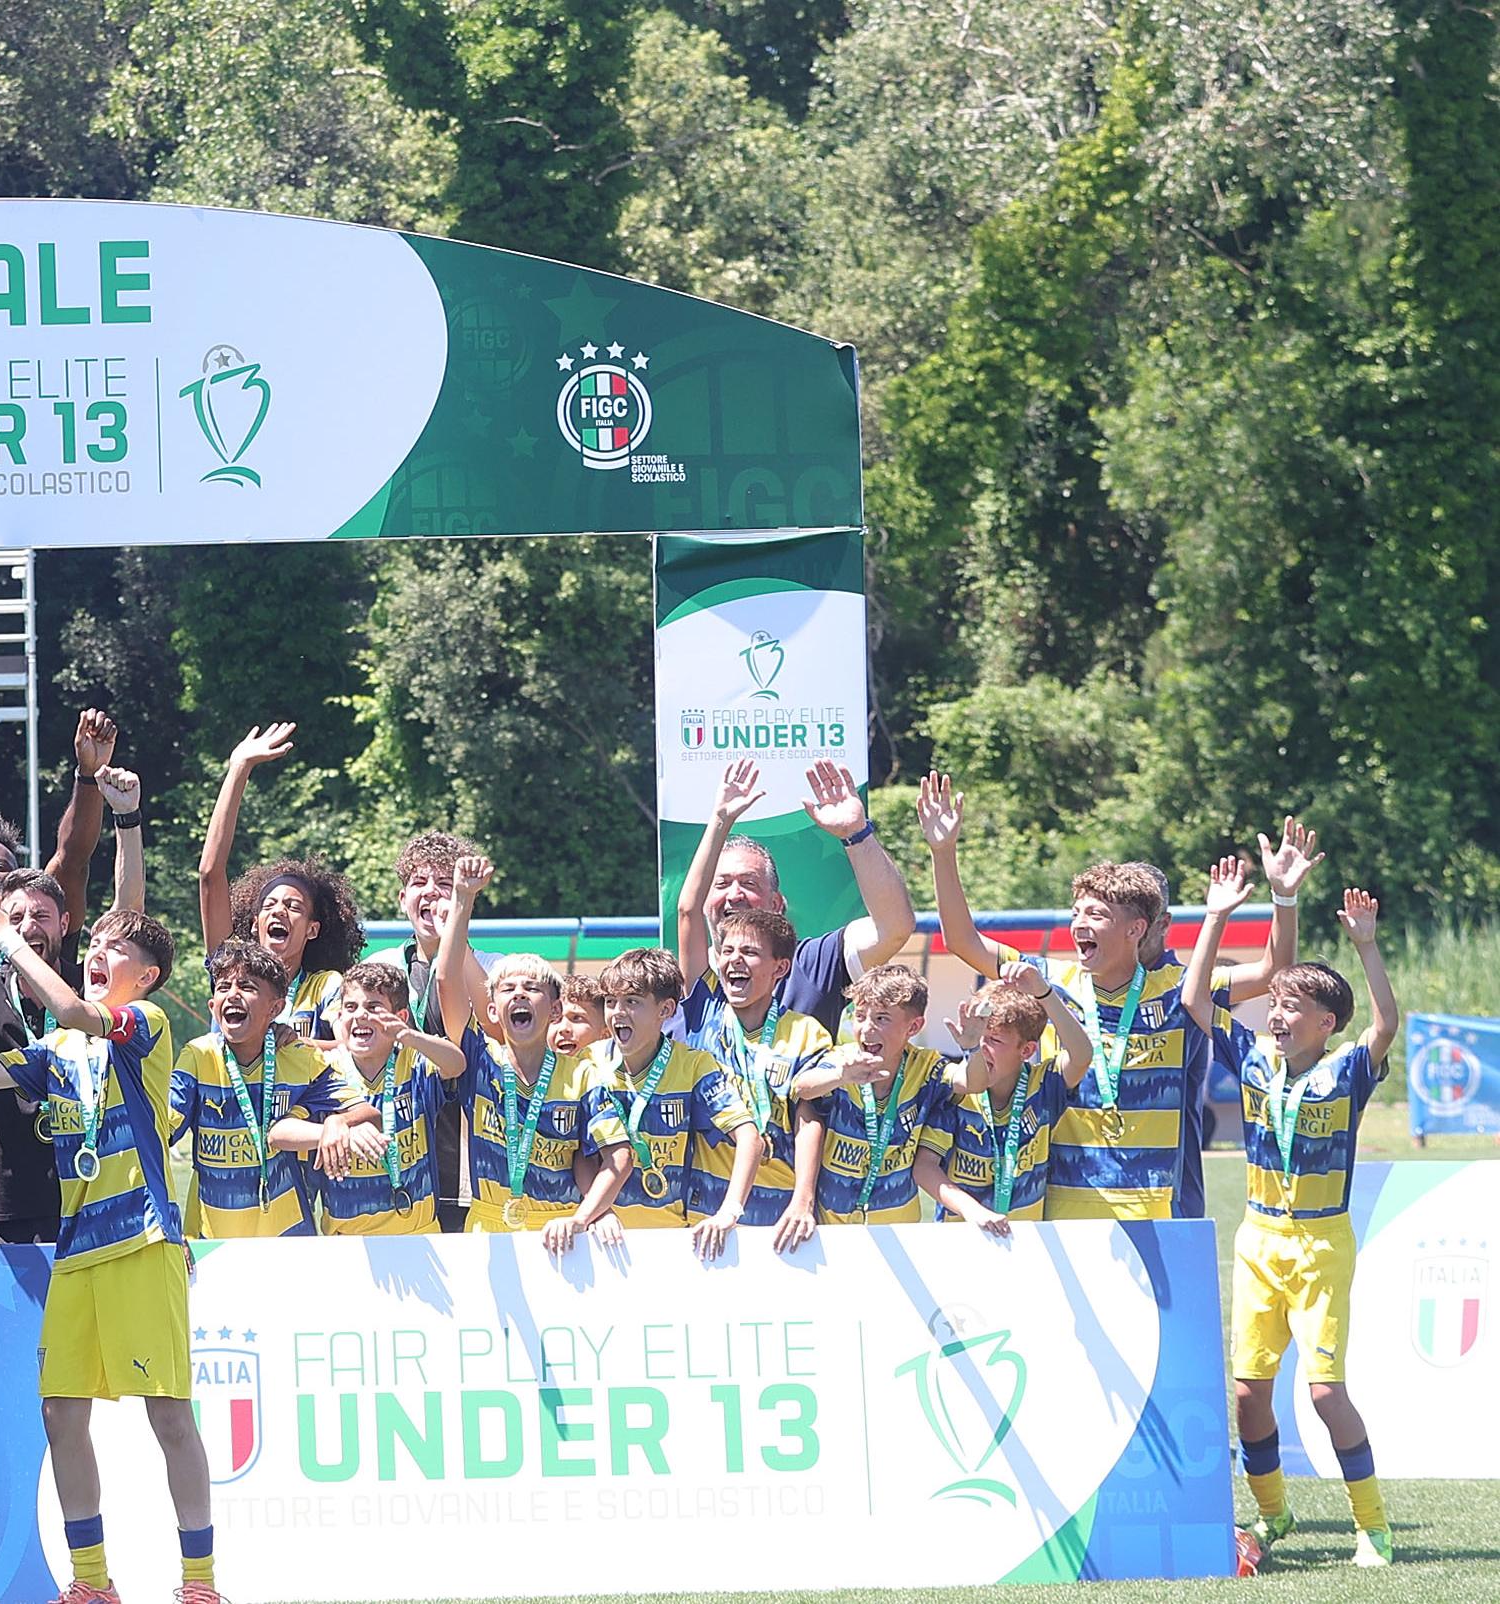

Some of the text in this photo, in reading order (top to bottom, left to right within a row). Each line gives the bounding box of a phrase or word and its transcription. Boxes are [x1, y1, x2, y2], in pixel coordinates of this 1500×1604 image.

[10, 357, 127, 400] ELITE
[581, 397, 628, 418] FIGC
[54, 401, 129, 465] 13
[595, 419, 614, 427] ITALIA
[631, 455, 668, 465] SETTORE
[631, 464, 684, 474] GIOVANILE E
[631, 472, 686, 482] SCOLASTICO
[712, 707, 844, 724] FAIR PLAY ELITE
[714, 723, 844, 748] UNDER 13
[681, 751, 723, 761] SETTORE
[726, 750, 776, 760] GIOVANILE
[788, 749, 846, 759] SCOLASTICO
[265, 1060, 275, 1100] FINALE
[384, 1067, 396, 1096] 2026
[526, 1054, 555, 1121] FINALE 2026
[1013, 1072, 1028, 1111] FINALE
[866, 1106, 879, 1147] FINALE
[1008, 1115, 1021, 1147] 2026
[229, 1134, 254, 1148] GA
[1420, 1266, 1480, 1284] ITALIA
[295, 1321, 816, 1387] FAIR PLAY ELITE
[192, 1361, 252, 1385] ALIA
[297, 1383, 820, 1482] UNDER 13
[212, 1485, 825, 1529] TTORE GIOVANILE E SCOLASTICO
